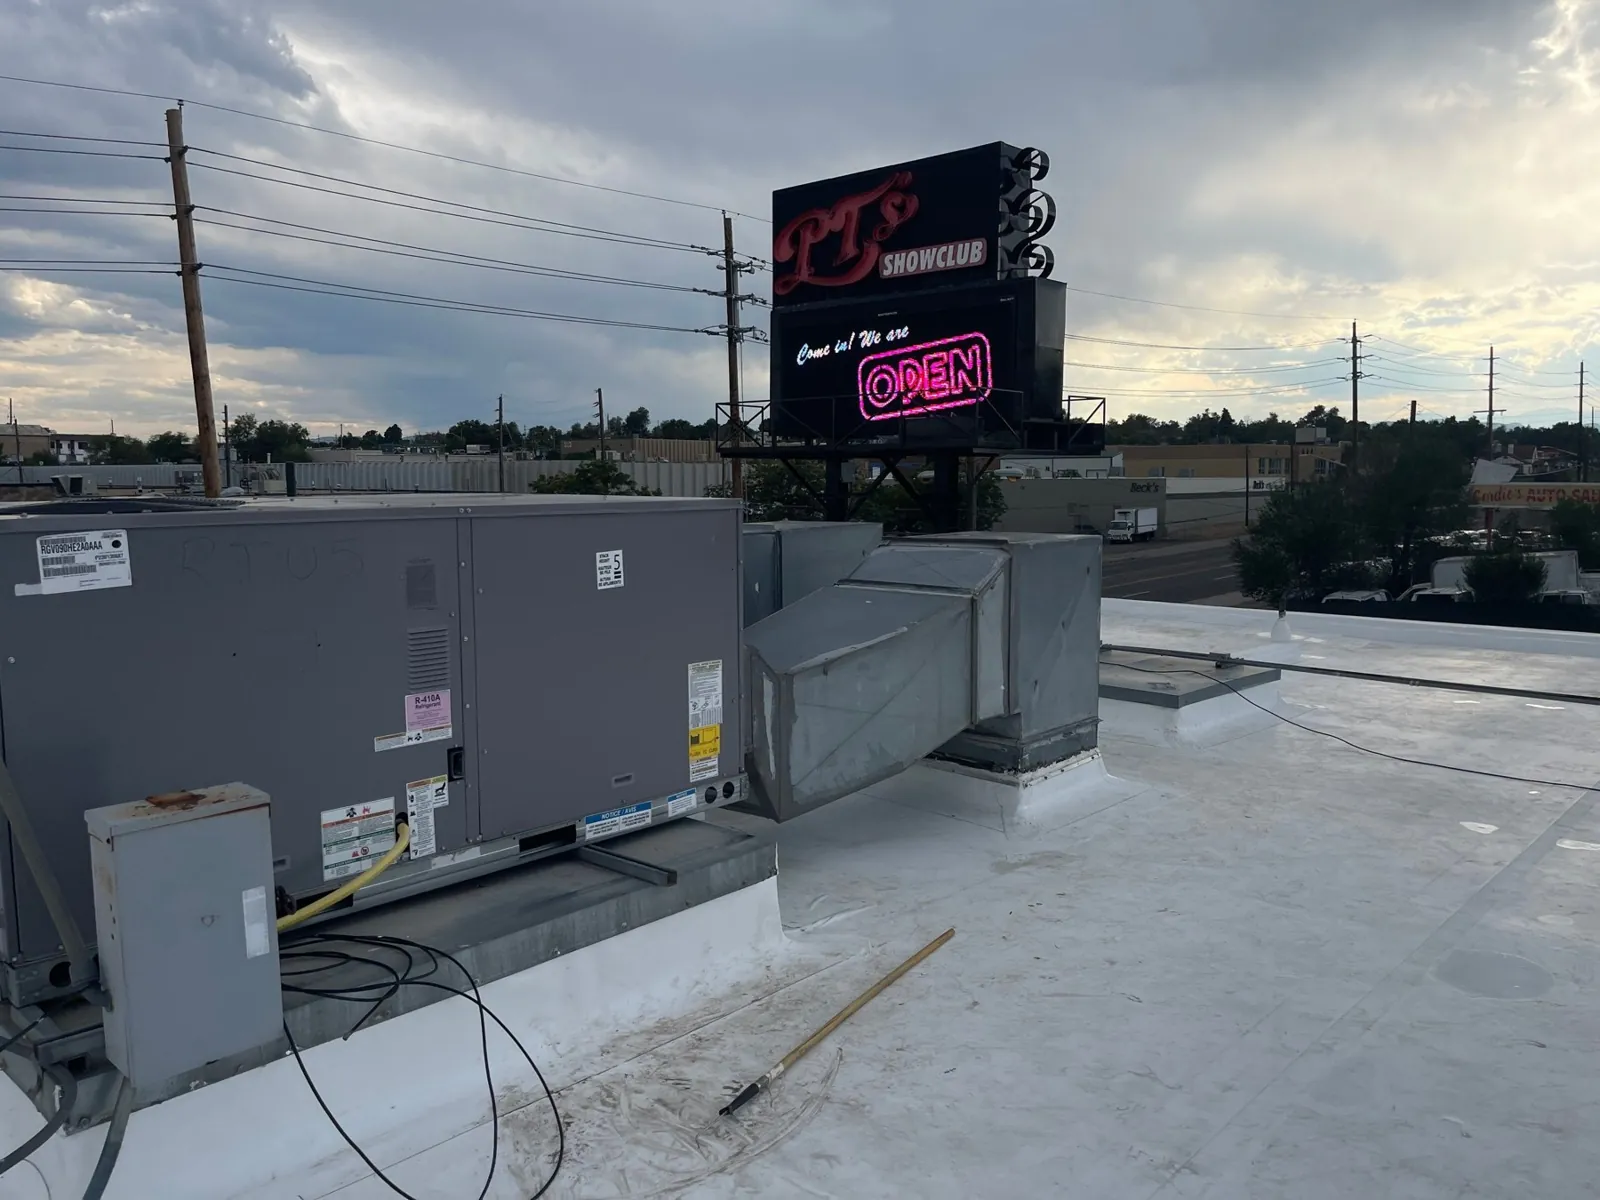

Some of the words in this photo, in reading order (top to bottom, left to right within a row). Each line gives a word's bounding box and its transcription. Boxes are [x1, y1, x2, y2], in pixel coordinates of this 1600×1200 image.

[882, 240, 984, 277] SHOWCLUB
[796, 343, 830, 366] Come
[834, 331, 856, 354] in!
[858, 329, 882, 349] We
[885, 325, 909, 342] are
[865, 343, 983, 409] OPEN
[1130, 481, 1160, 493] Beck's
[1526, 488, 1566, 502] AUTO
[613, 553, 621, 571] 5
[414, 693, 441, 705] R-410A
[601, 810, 621, 820] NOTICE
